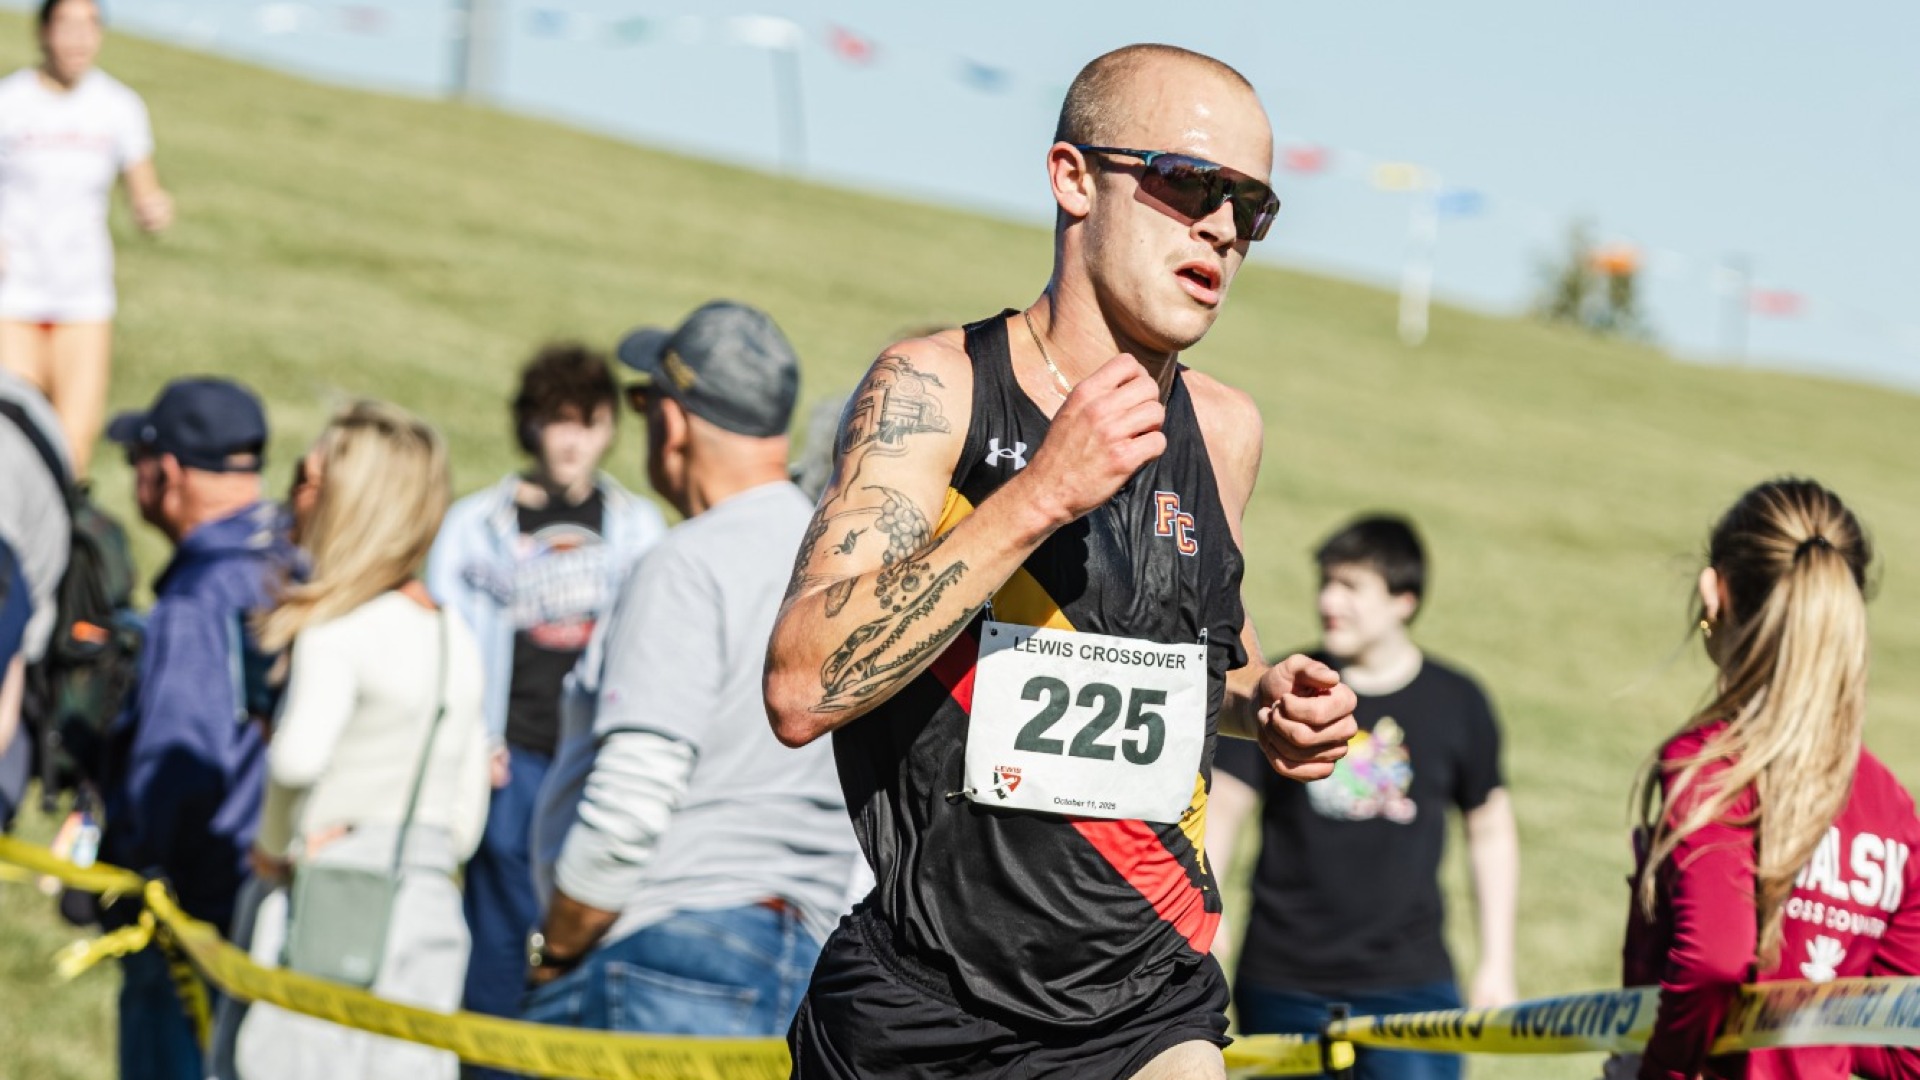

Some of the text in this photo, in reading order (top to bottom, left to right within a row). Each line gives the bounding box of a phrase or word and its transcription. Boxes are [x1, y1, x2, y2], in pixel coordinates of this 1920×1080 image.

[1013, 635, 1186, 669] LEWIS CROSSOVER
[1013, 675, 1167, 766] 225
[994, 765, 1022, 774] LEWIS
[1053, 796, 1084, 807] October
